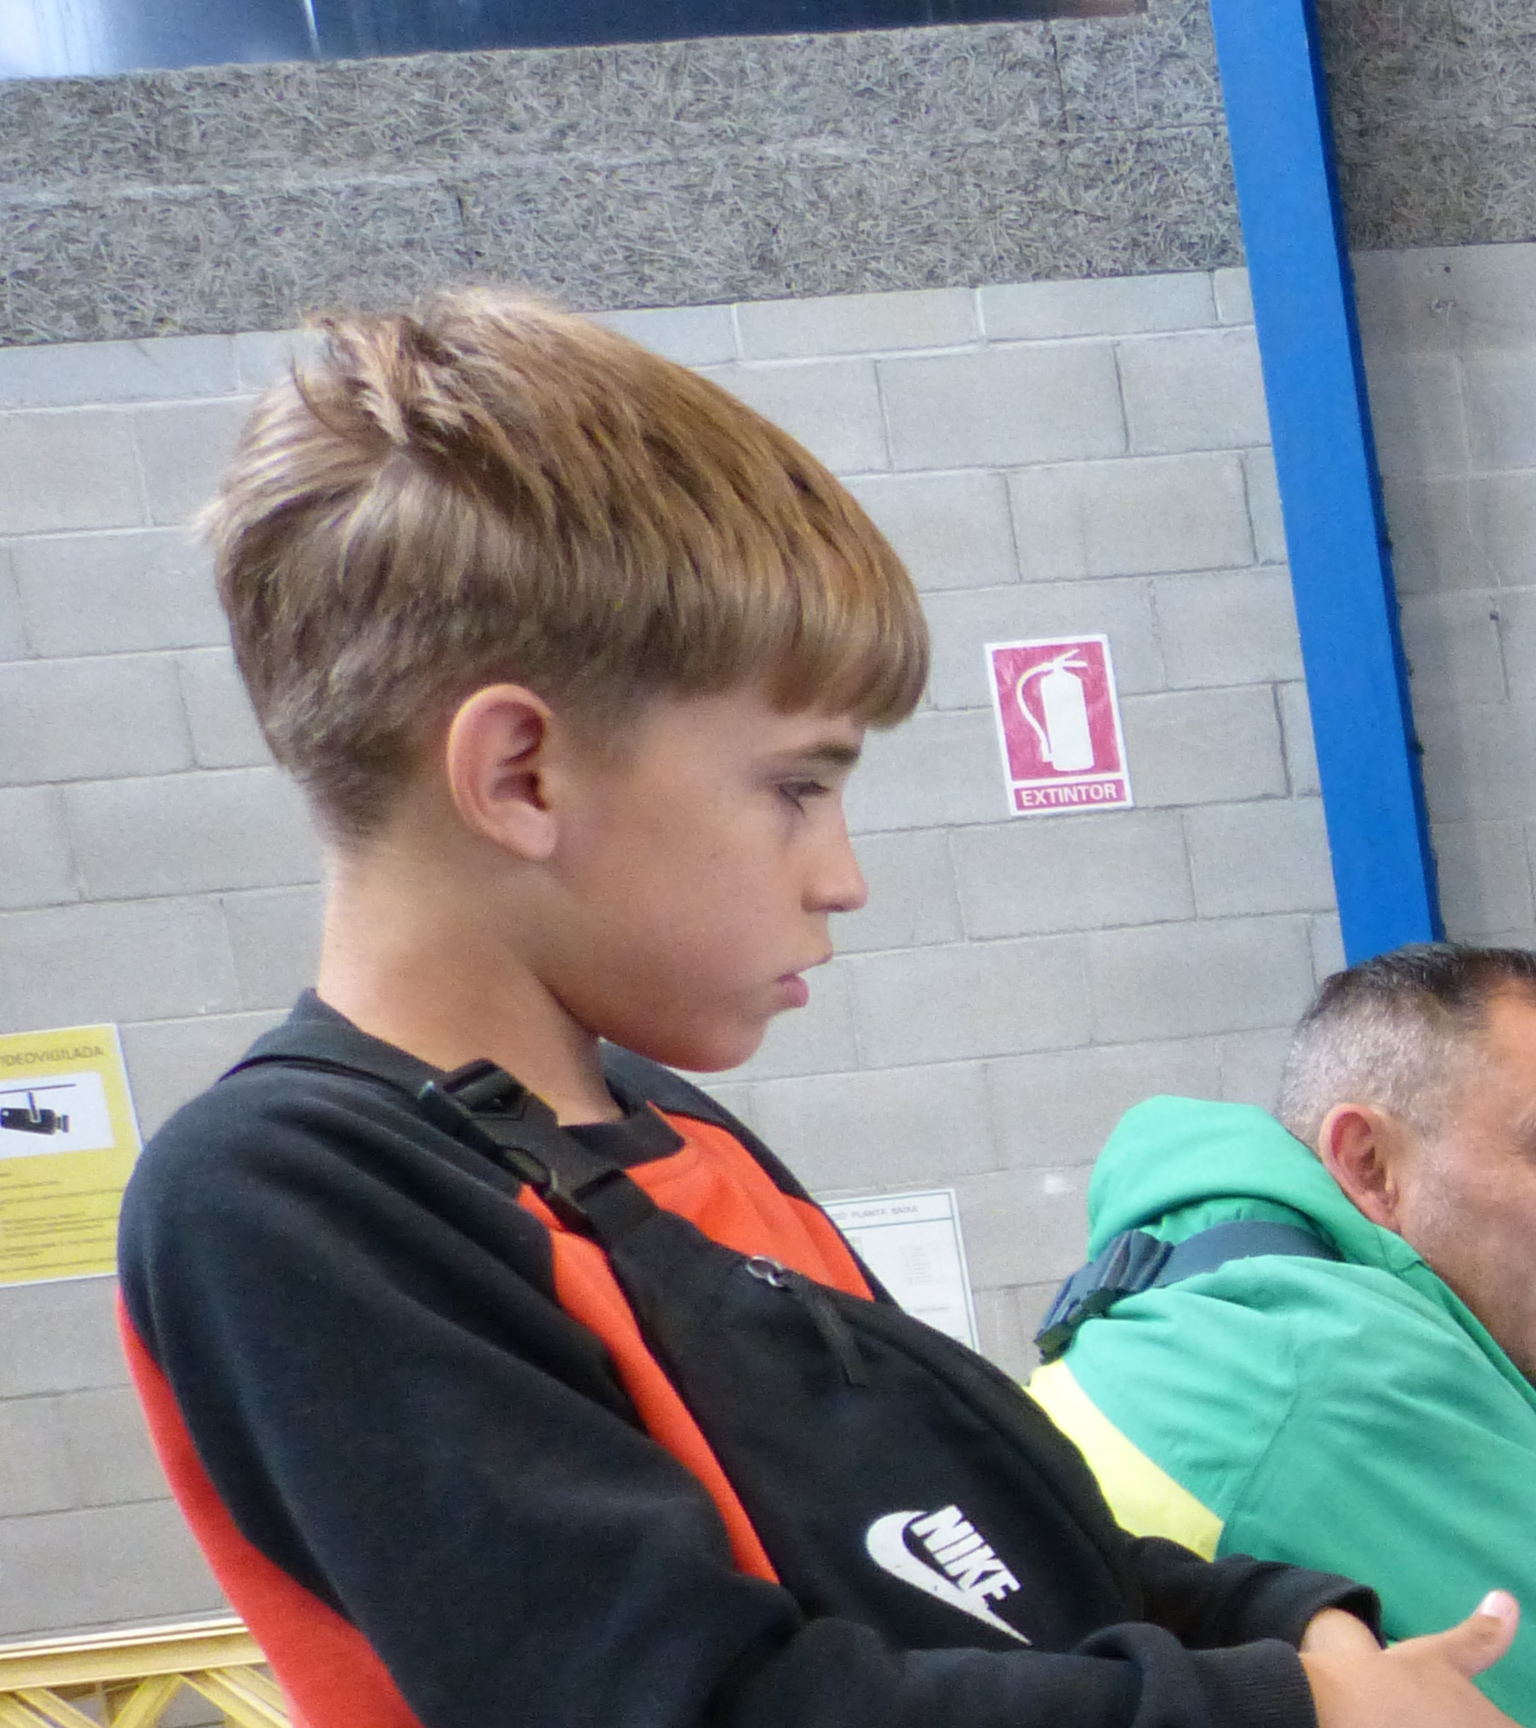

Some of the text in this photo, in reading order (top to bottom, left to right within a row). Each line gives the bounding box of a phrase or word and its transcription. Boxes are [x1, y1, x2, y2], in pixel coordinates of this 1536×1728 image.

[1021, 783, 1118, 806] EXTINTOR
[0, 1046, 105, 1067] IDEOVIGILADA
[909, 1504, 1022, 1607] NIKE
